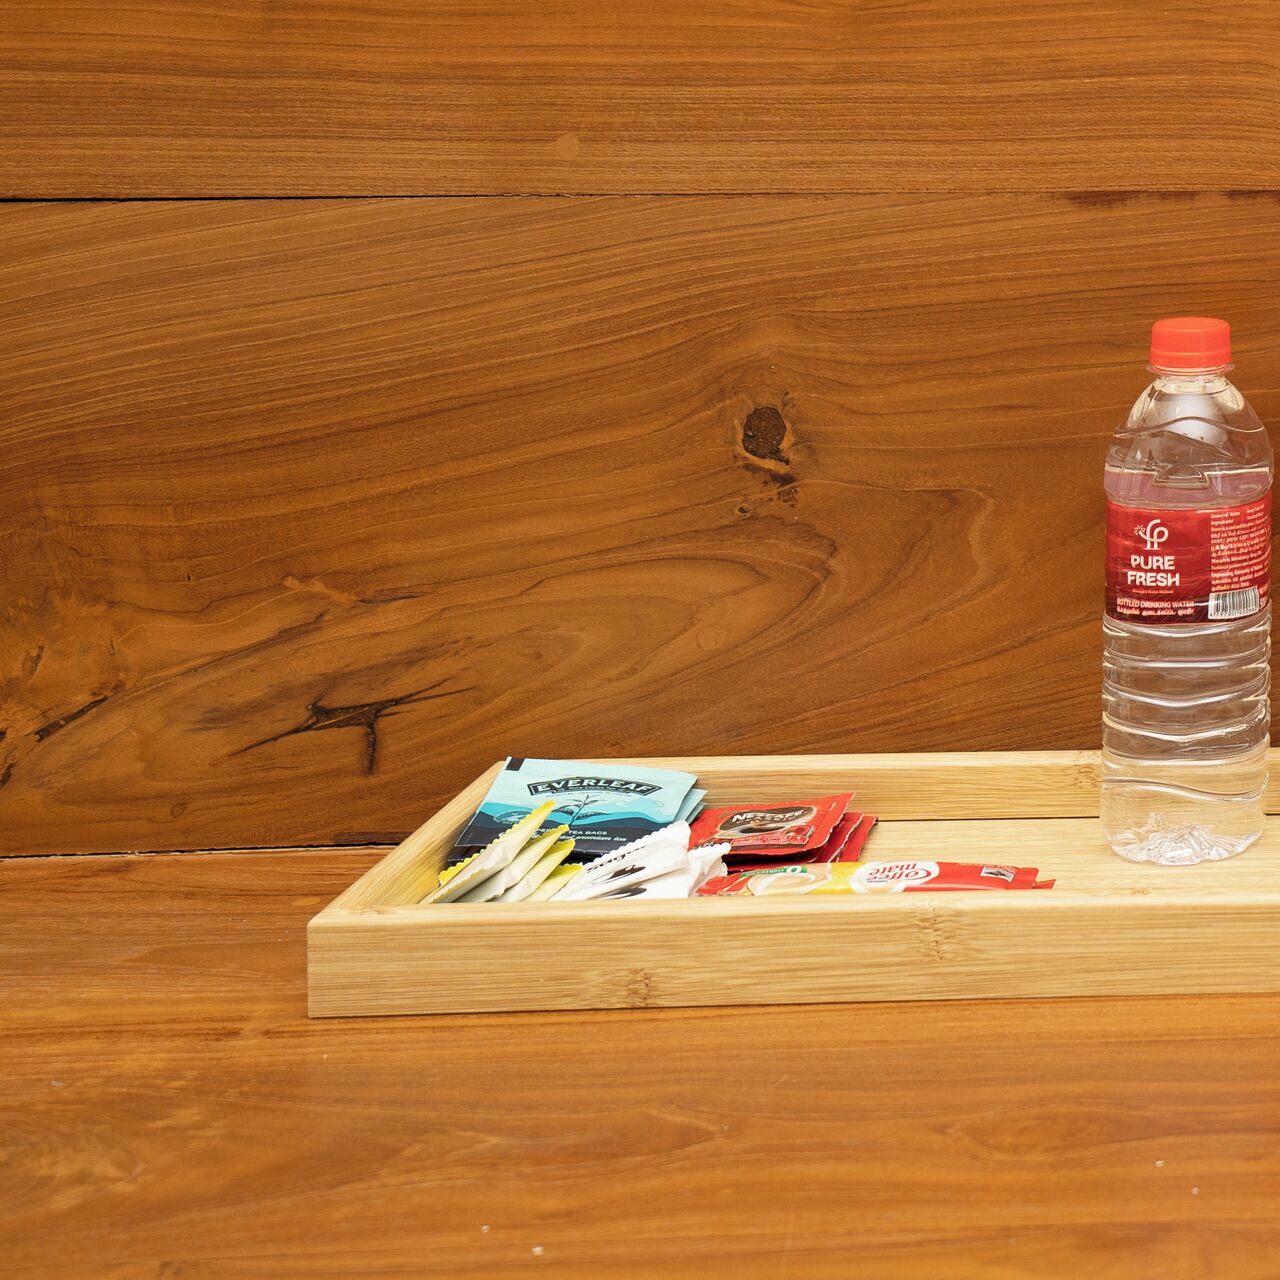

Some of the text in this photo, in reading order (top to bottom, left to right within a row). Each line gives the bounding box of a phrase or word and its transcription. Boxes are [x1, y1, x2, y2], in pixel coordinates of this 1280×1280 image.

[1130, 554, 1175, 570] PURE
[1127, 571, 1180, 586] FRESH
[1116, 597, 1195, 608] BOTTLED DRINKING WATER
[537, 777, 654, 795] EVERLEAF
[867, 869, 932, 881] Coffee
[869, 863, 917, 875] mate
